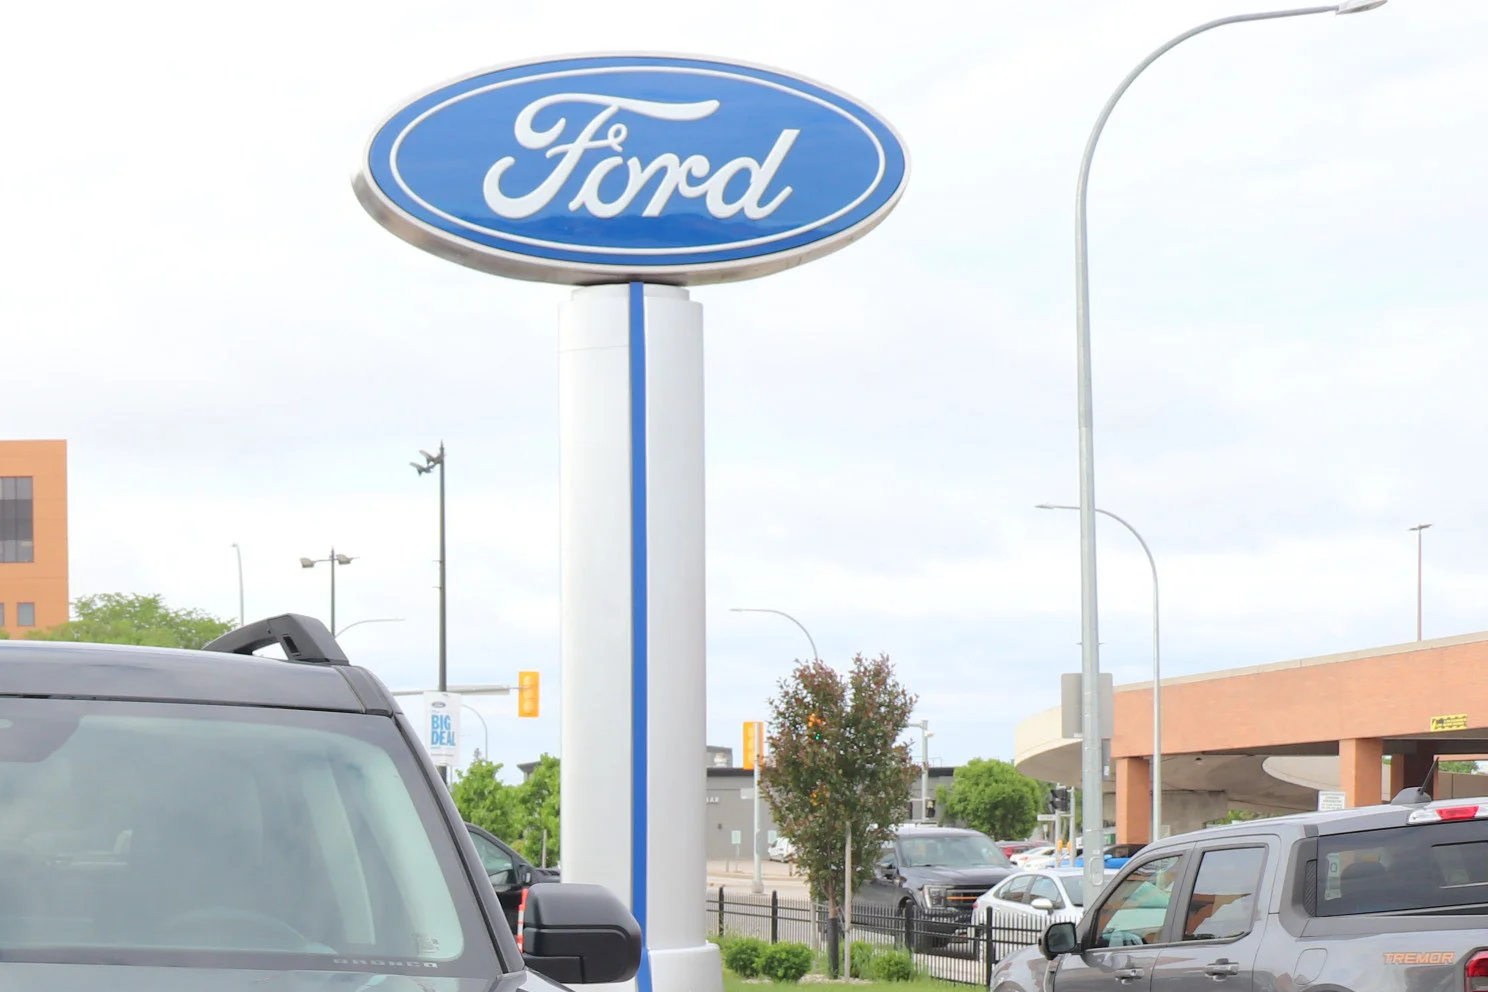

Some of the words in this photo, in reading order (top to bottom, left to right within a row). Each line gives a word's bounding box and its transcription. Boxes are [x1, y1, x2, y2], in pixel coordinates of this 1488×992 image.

[482, 92, 800, 219] Ford
[431, 713, 451, 731] BIG
[431, 730, 457, 747] DEAL
[1383, 951, 1456, 965] TREMOR
